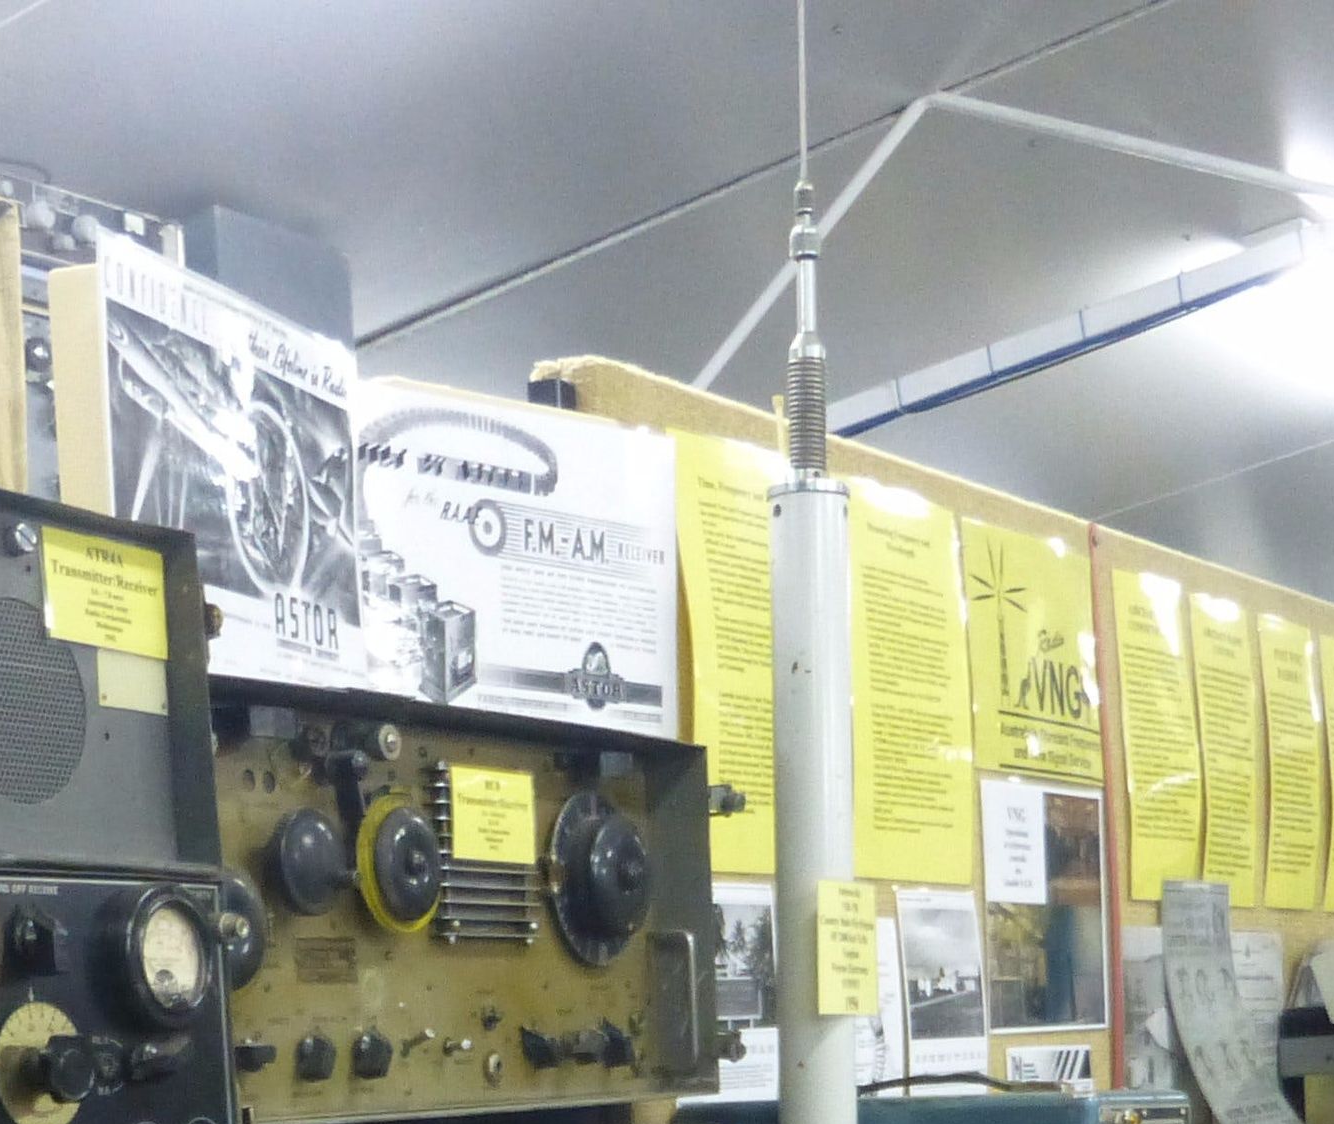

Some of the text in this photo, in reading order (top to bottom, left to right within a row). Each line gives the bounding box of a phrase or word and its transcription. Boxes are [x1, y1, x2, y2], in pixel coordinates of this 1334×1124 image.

[274, 592, 339, 649] ASTOR
[570, 677, 624, 698] ASTOR
[1031, 656, 1082, 719] VNG
